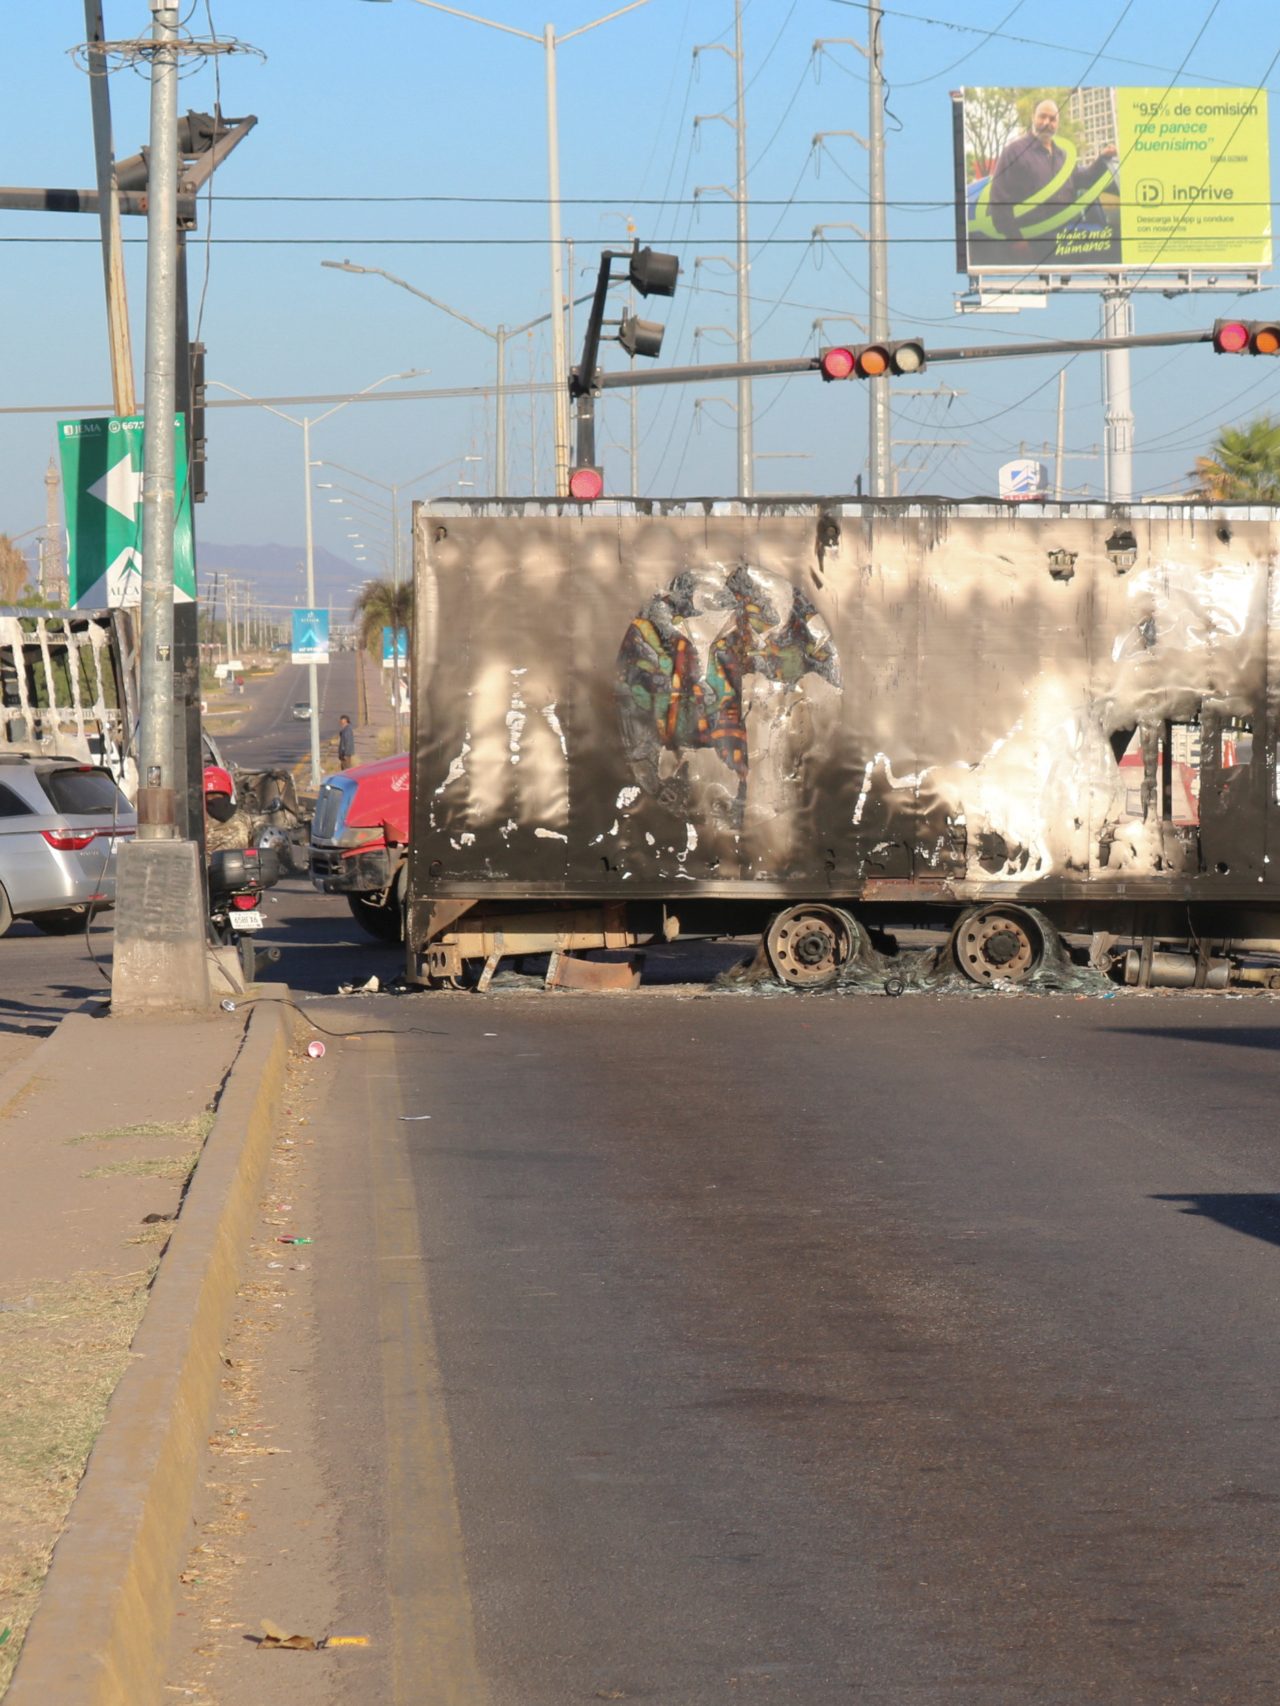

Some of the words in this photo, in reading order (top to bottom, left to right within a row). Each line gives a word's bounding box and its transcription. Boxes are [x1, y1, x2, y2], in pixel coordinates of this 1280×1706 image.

[1174, 102, 1191, 116] de
[1195, 102, 1258, 116] comisión
[1134, 123, 1156, 134] me
[1160, 123, 1207, 137] parece
[1172, 184, 1234, 201] inDrive
[1136, 215, 1172, 224] Descarga
